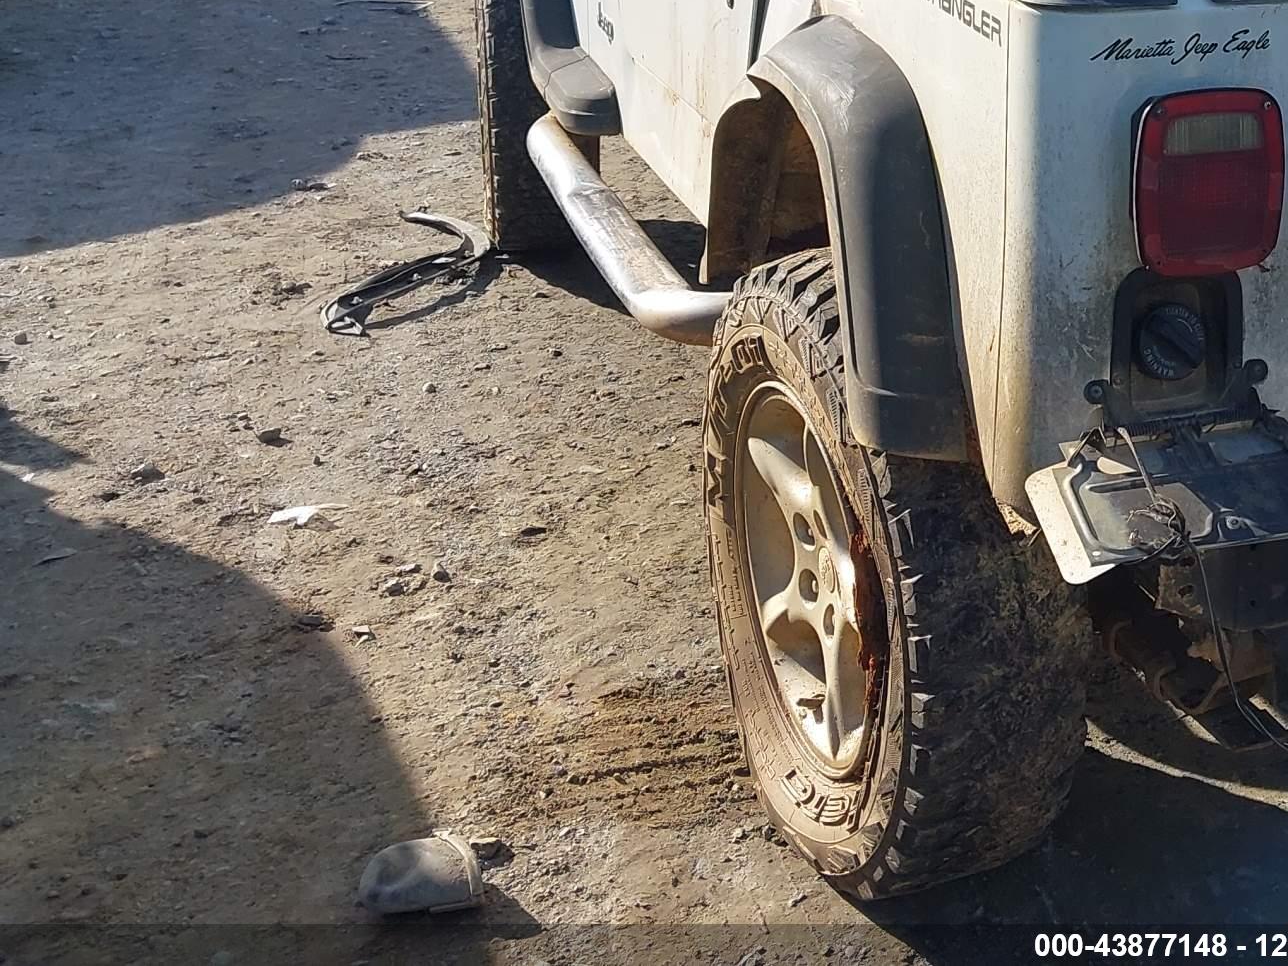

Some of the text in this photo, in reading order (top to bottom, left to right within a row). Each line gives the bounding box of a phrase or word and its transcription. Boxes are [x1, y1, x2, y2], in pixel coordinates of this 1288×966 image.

[1089, 28, 1271, 66] Marietta Jeep Eagle
